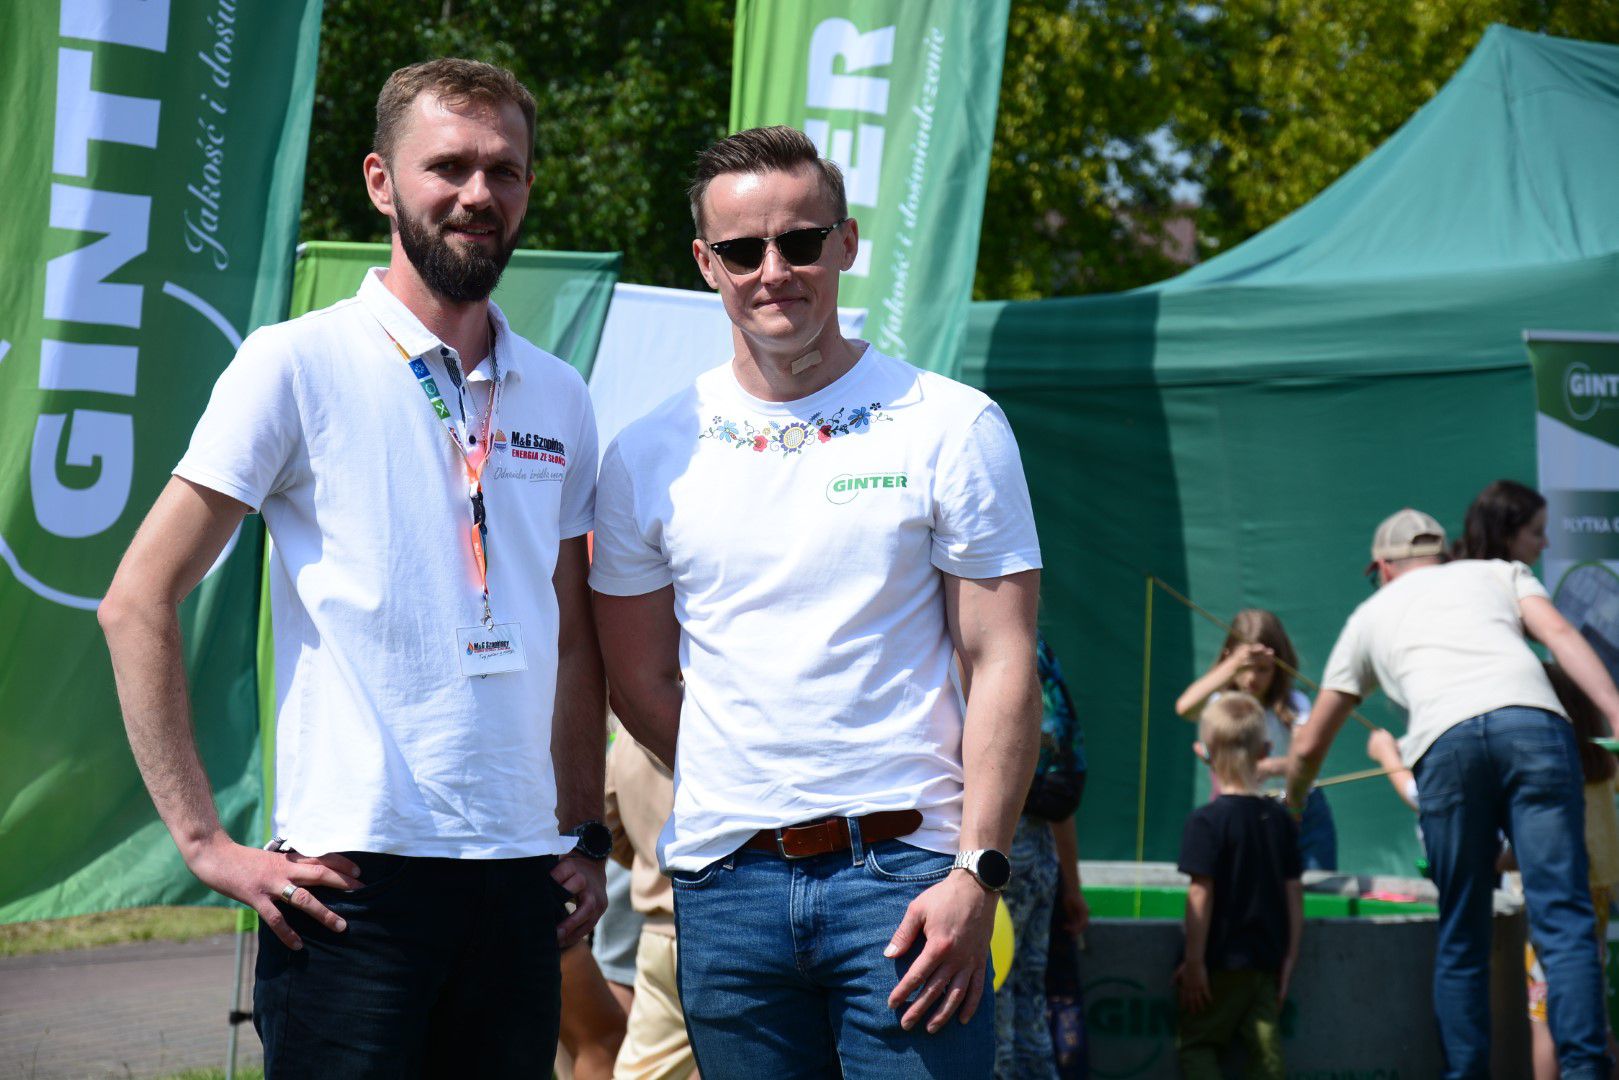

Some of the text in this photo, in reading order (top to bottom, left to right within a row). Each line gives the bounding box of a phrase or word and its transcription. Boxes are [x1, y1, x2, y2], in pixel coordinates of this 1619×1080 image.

[200, 93, 228, 114] i
[184, 118, 229, 270] Jakość
[511, 431, 531, 446] M&G
[512, 449, 539, 460] ENERGIA
[540, 453, 547, 462] ZE
[833, 476, 908, 492] GINTER
